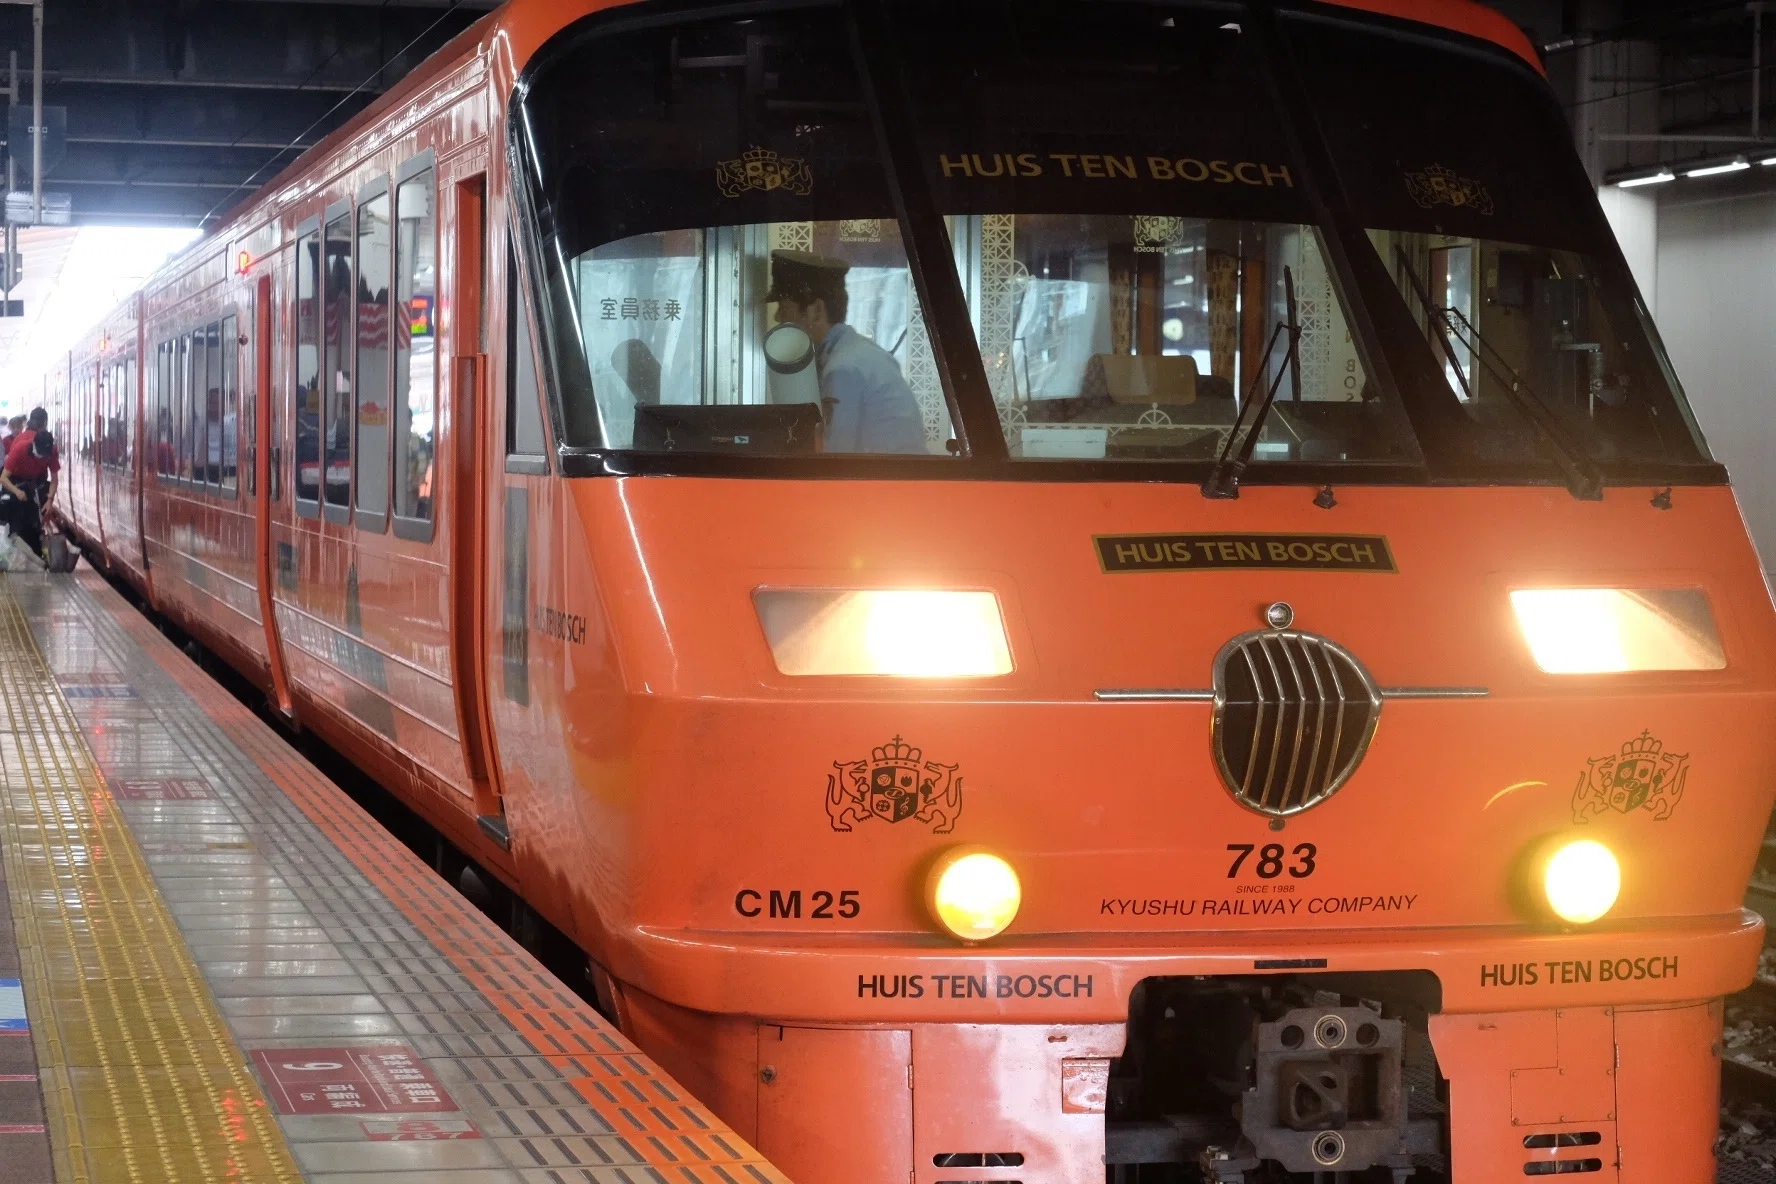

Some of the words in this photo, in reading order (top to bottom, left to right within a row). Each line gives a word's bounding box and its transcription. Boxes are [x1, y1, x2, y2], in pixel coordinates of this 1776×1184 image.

[940, 153, 1043, 178] HUIS
[1050, 154, 1138, 179] TEN
[1146, 156, 1294, 188] BOSCH
[1114, 542, 1192, 563] HUIS
[1195, 541, 1261, 561] TEN
[1267, 542, 1376, 563] BOSCH
[1226, 842, 1317, 879] 783
[1236, 885, 1268, 894] SINCE
[1273, 885, 1295, 893] 1988
[1100, 899, 1197, 916] KYUSHU
[1201, 898, 1303, 915] RAILWAY
[1307, 894, 1418, 913] COMPANY
[1480, 962, 1538, 987] HUIS
[1545, 960, 1592, 985] TEN
[1600, 955, 1679, 982] BOSCH
[858, 974, 924, 999] HUIS
[931, 974, 988, 999] TEN
[996, 974, 1093, 998] BOSCH
